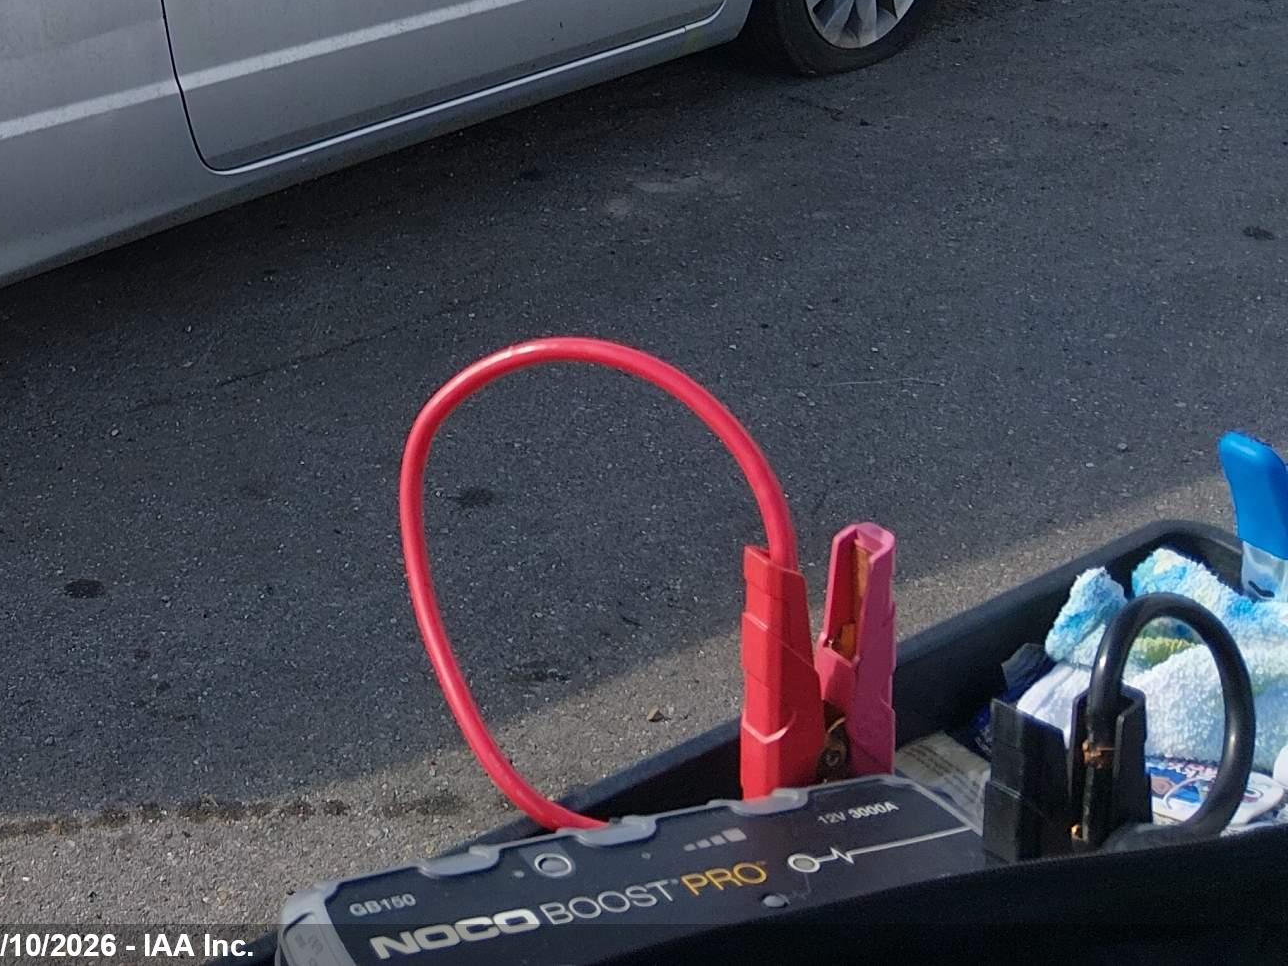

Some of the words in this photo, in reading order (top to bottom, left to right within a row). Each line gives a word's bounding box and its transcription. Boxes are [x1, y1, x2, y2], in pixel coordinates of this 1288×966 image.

[817, 811, 847, 824] 12V
[847, 801, 899, 819] 3000A
[349, 893, 416, 917] GB150
[369, 908, 541, 960] NOCO
[539, 881, 673, 926] BOOST
[680, 862, 767, 896] PRO
